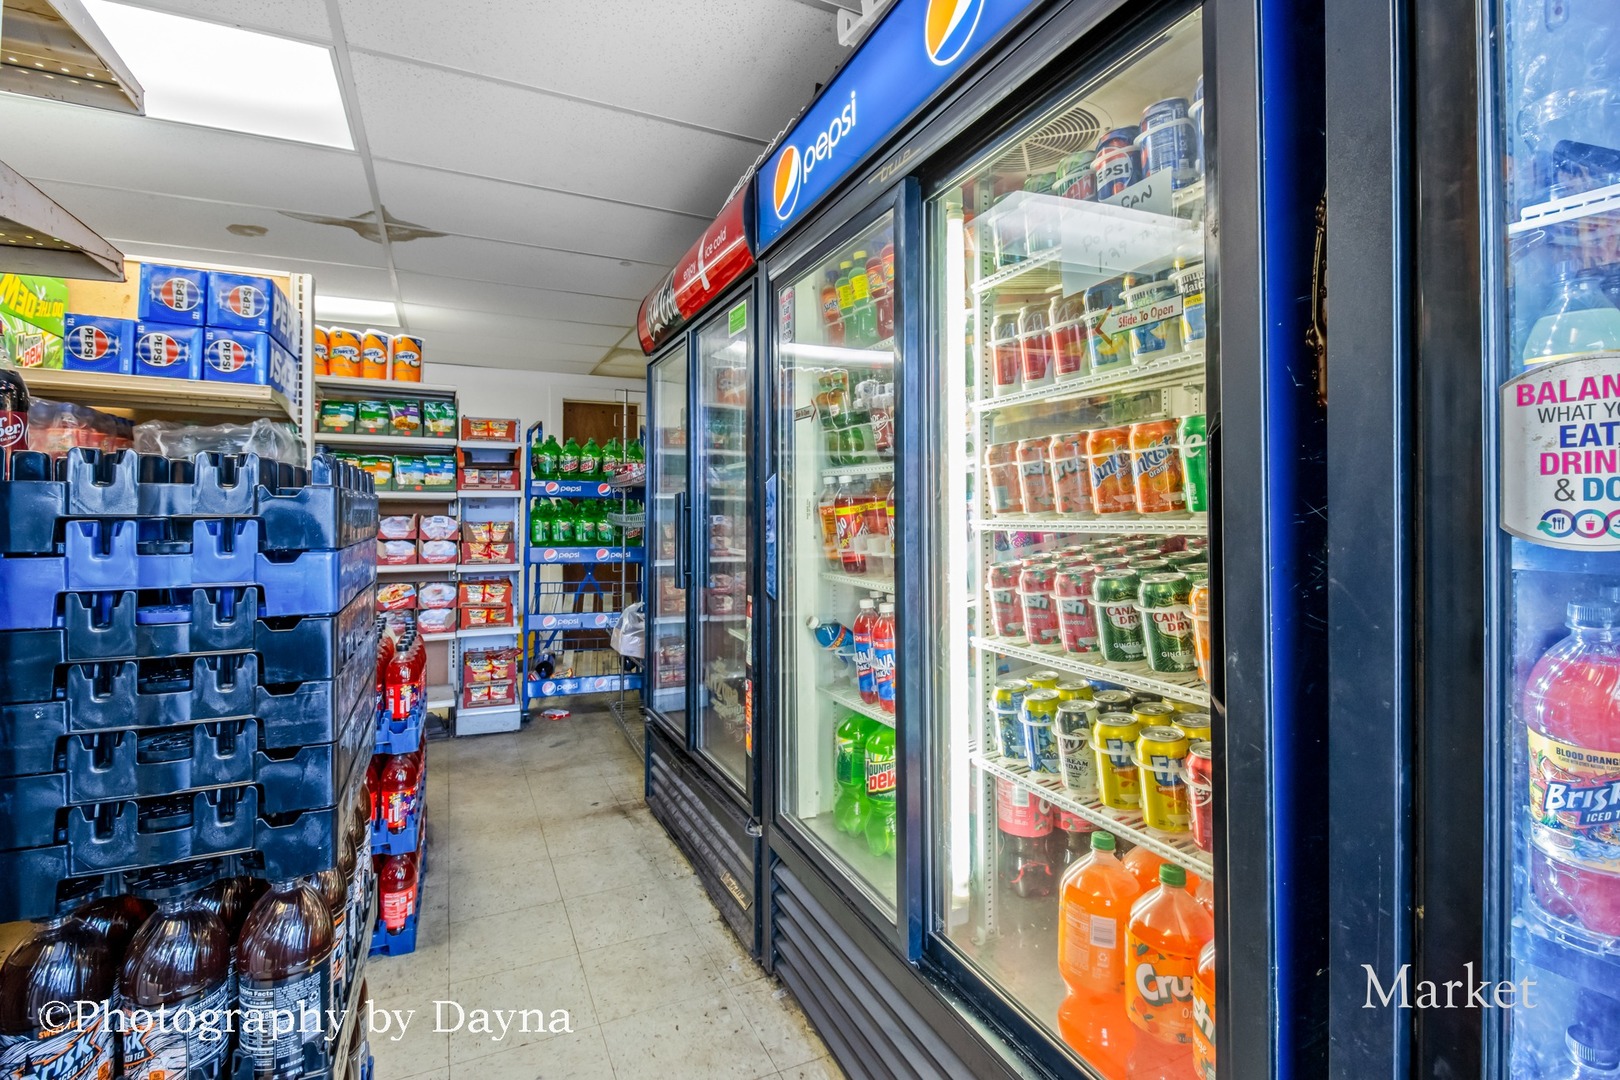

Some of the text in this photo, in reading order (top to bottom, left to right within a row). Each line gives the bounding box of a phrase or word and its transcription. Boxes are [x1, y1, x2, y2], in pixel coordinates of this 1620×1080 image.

[803, 90, 857, 184] pepsi
[1121, 184, 1153, 208] CAN
[704, 226, 727, 259] ice cold
[683, 260, 697, 281] enjoy
[0, 272, 65, 319] DO THE DEW
[174, 279, 186, 311] PEPSI
[242, 286, 252, 317] PEPSI
[1118, 313, 1138, 329] Slide
[1140, 309, 1149, 322] To
[1150, 303, 1174, 319] Open
[84, 327, 95, 361] PEPSI
[153, 334, 164, 365] PEPSI
[221, 341, 232, 371] PEPSI
[1516, 374, 1620, 408] BALAN
[1538, 402, 1597, 424] WHAT
[1148, 460, 1174, 478] Orange
[1540, 449, 1620, 476] DRIN
[560, 485, 582, 494] pepsi
[1554, 478, 1576, 502] &
[558, 551, 580, 559] pepsi
[1106, 606, 1137, 617] CANA
[1119, 615, 1140, 625] DRY
[1153, 611, 1187, 623] CANA
[557, 618, 579, 627] pepsi
[1167, 620, 1191, 632] DRY
[1113, 641, 1141, 649] GINGER
[1161, 650, 1190, 658] GINGER
[556, 682, 579, 692] pepsi
[1556, 747, 1620, 766] BLOOD ORANG
[1586, 811, 1612, 823] ICED
[1136, 963, 1194, 1007] Cru
[80, 1051, 95, 1068] TEA
